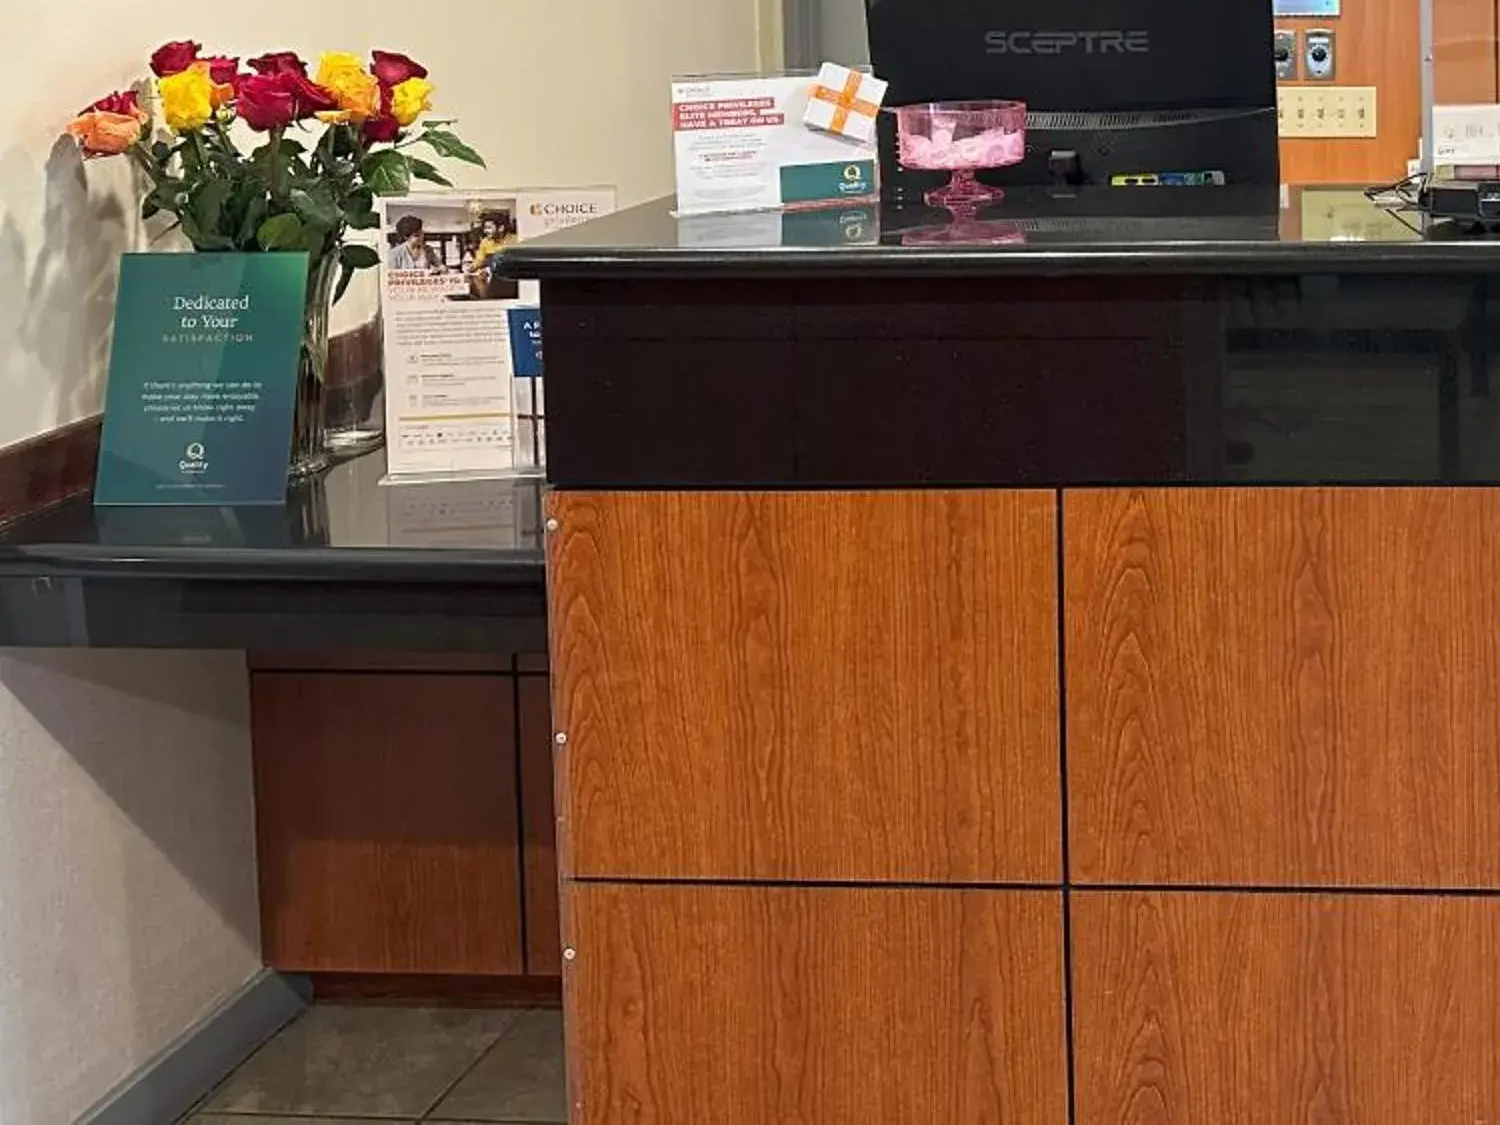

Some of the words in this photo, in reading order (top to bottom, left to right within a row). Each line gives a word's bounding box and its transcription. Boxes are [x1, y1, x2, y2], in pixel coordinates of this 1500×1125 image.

[984, 29, 1150, 55] SCEPTRE
[543, 202, 599, 215] CHOICE
[173, 294, 250, 311] Dedicated
[181, 316, 197, 329] to
[201, 314, 239, 329] Your
[162, 332, 255, 344] SATISFACTION
[179, 460, 209, 471] Quality
